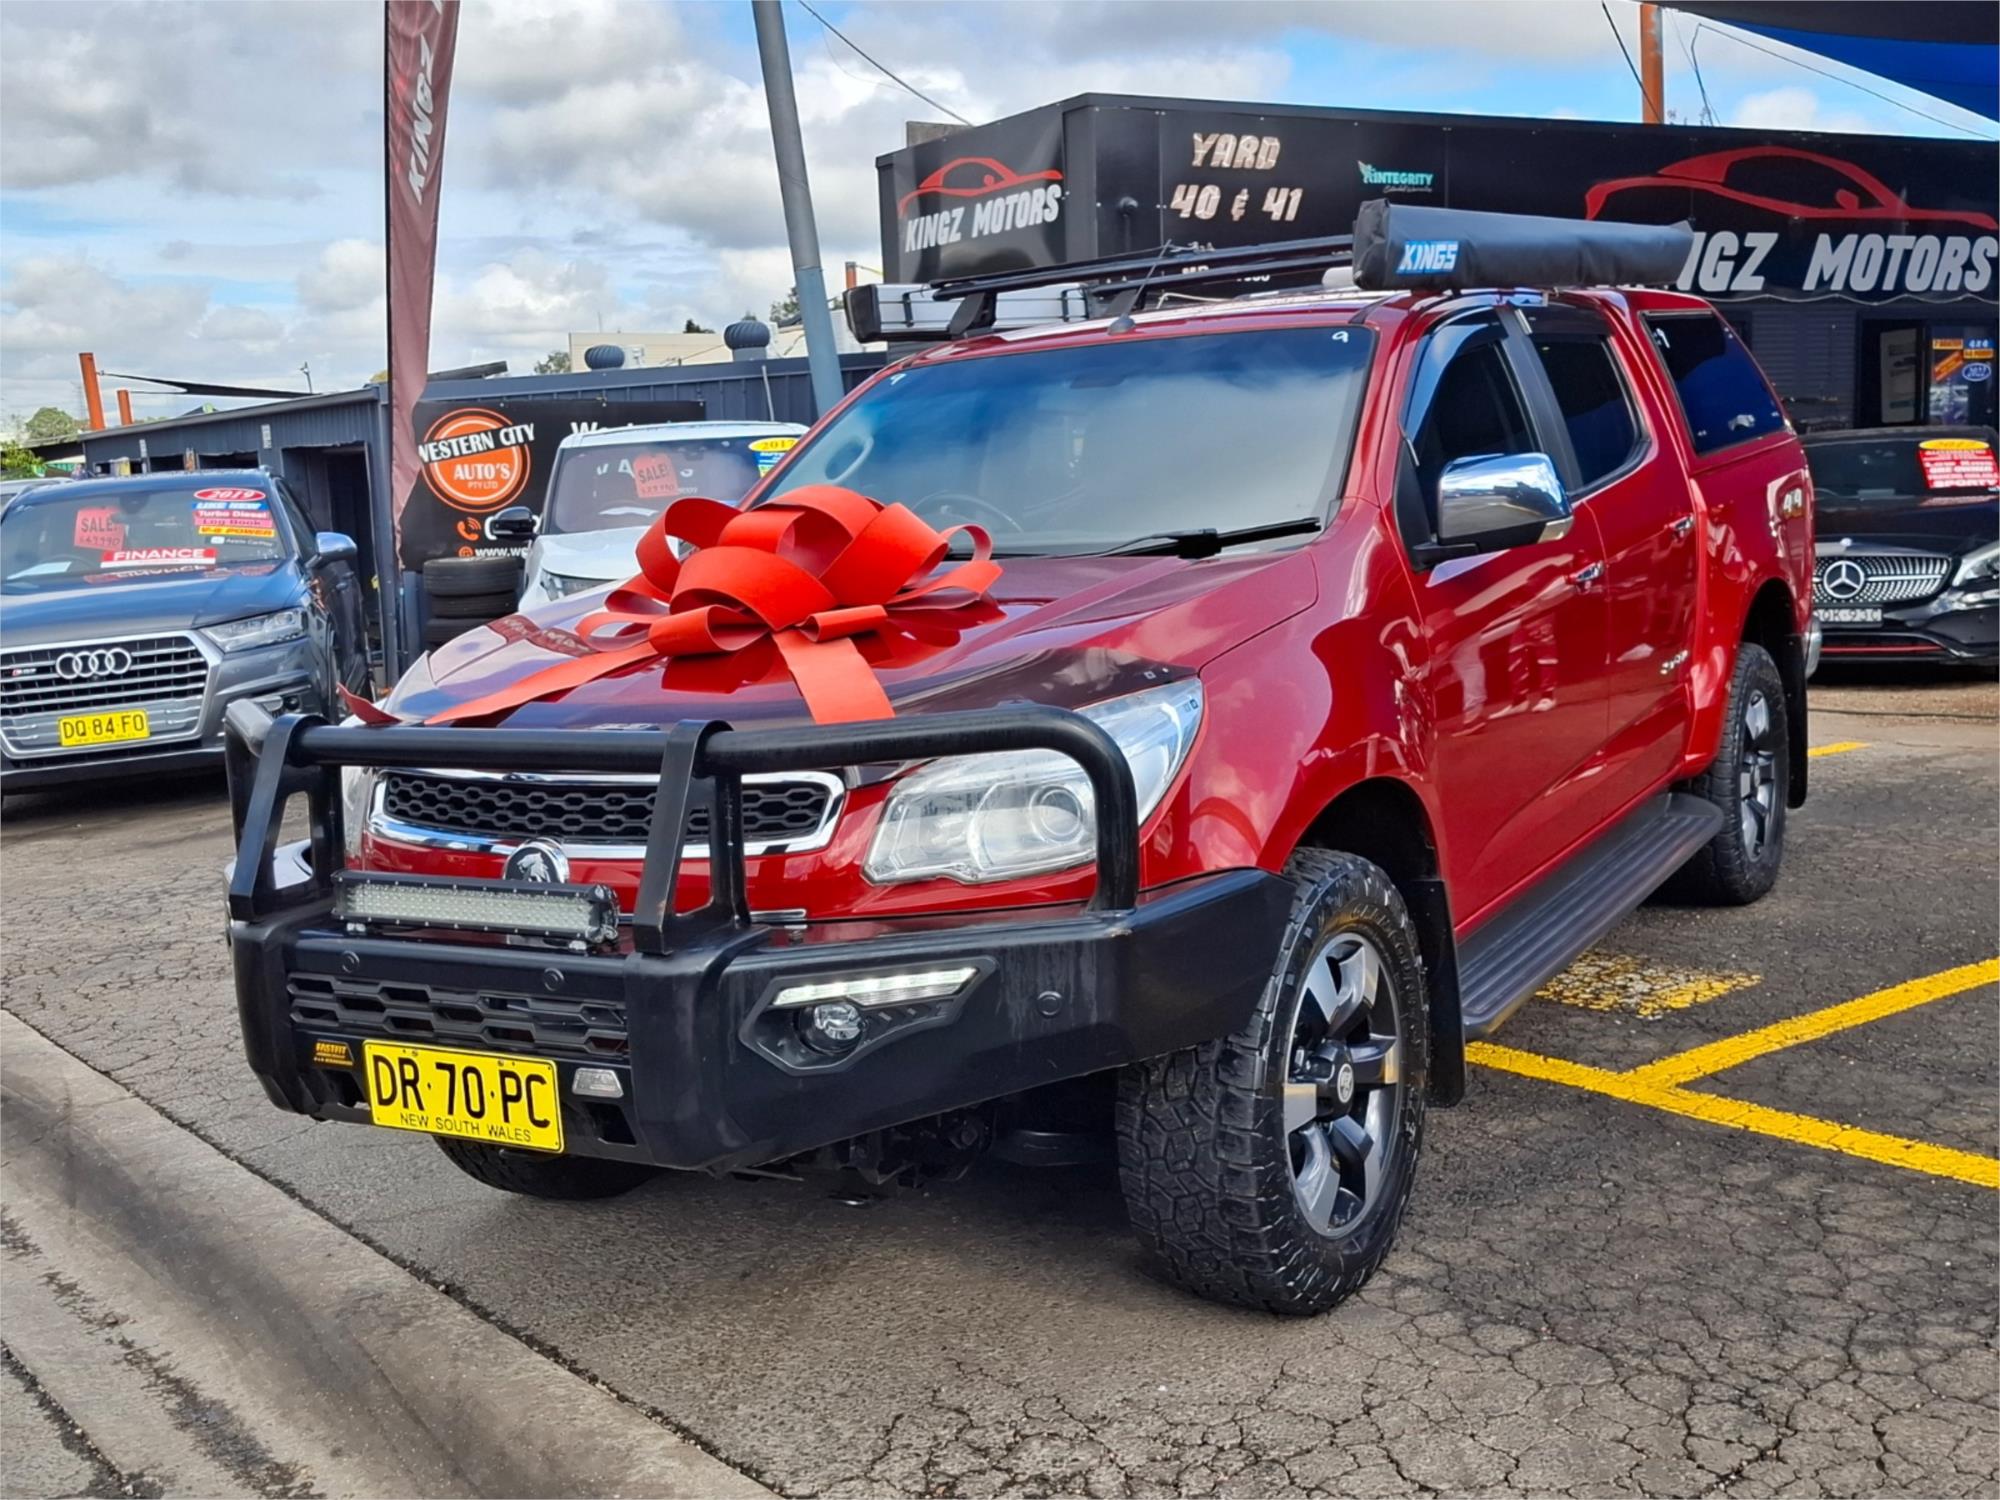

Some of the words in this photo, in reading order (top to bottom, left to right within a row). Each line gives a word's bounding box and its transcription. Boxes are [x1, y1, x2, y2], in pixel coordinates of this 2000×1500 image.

[408, 33, 434, 206] KINGZ
[1192, 133, 1281, 169] YARD
[905, 206, 961, 252] KINGZ
[972, 184, 1062, 237] MOTORS
[1170, 184, 1218, 220] 40
[1262, 187, 1303, 221] 41
[1802, 233, 1998, 293] MOTORS
[500, 423, 535, 446] CITY
[453, 463, 511, 481] AUTO'S
[209, 489, 256, 499] 2019
[199, 510, 230, 518] Turbo
[232, 510, 267, 519] Diesel
[113, 549, 206, 561] FINANCE
[400, 1112, 429, 1129] NEW
[435, 1116, 480, 1136] SOUTH
[486, 1124, 532, 1143] WALES
